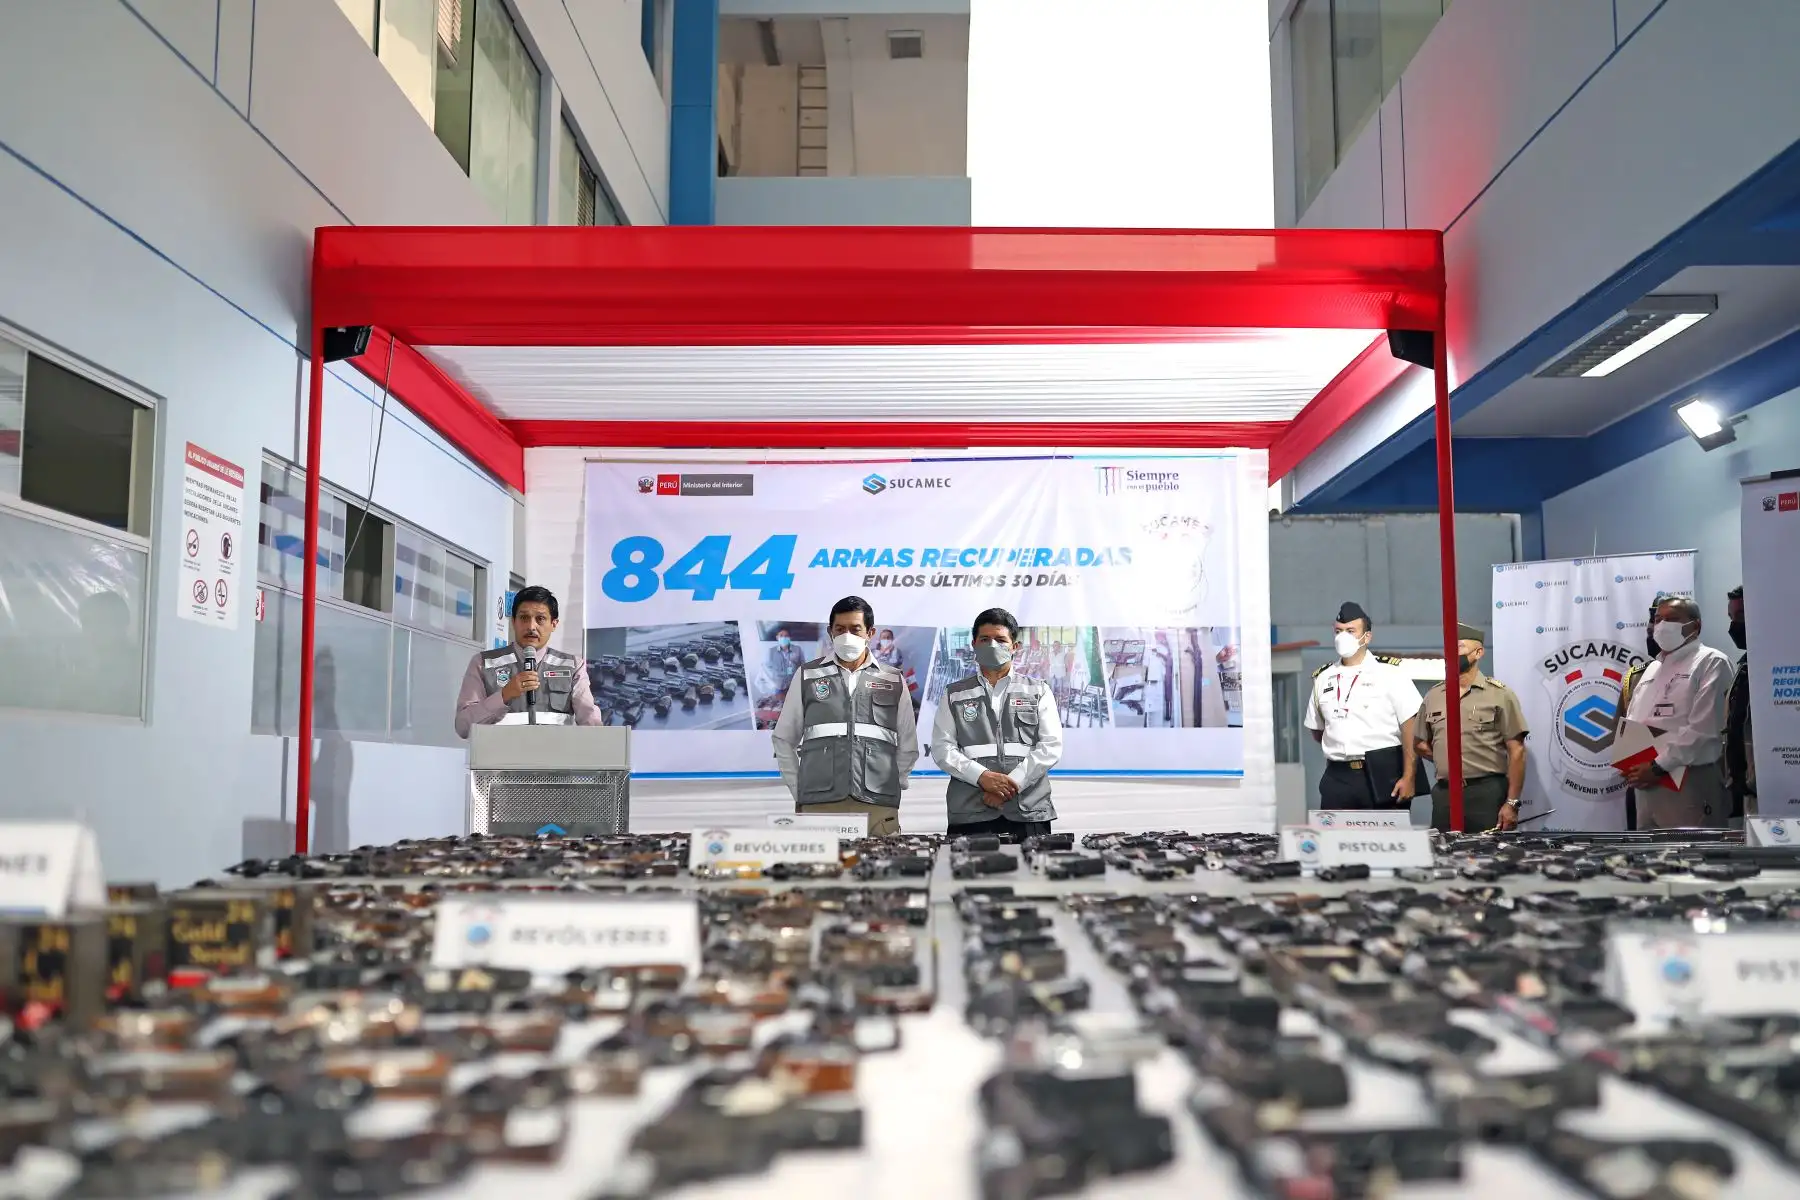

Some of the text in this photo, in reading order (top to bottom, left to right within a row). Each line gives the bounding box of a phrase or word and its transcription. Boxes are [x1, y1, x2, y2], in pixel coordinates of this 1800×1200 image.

[1126, 470, 1179, 483] Siempre
[659, 480, 678, 488] PERÚ
[682, 481, 712, 489] Ministerio
[889, 478, 952, 489] SUCAMEC
[1145, 481, 1179, 493] pueblo
[808, 546, 1133, 569] ARMAS RECUPERADAS
[601, 534, 798, 603] 844
[862, 570, 1080, 588] EN LOS ÚLTIMOS 30 DÍA
[1773, 678, 1800, 686] REGI
[1565, 778, 1598, 795] PREVENIR
[733, 841, 826, 854] REVÓLVERES
[1338, 842, 1407, 852] PISTOLAS
[510, 923, 670, 945] REVÓLVERES
